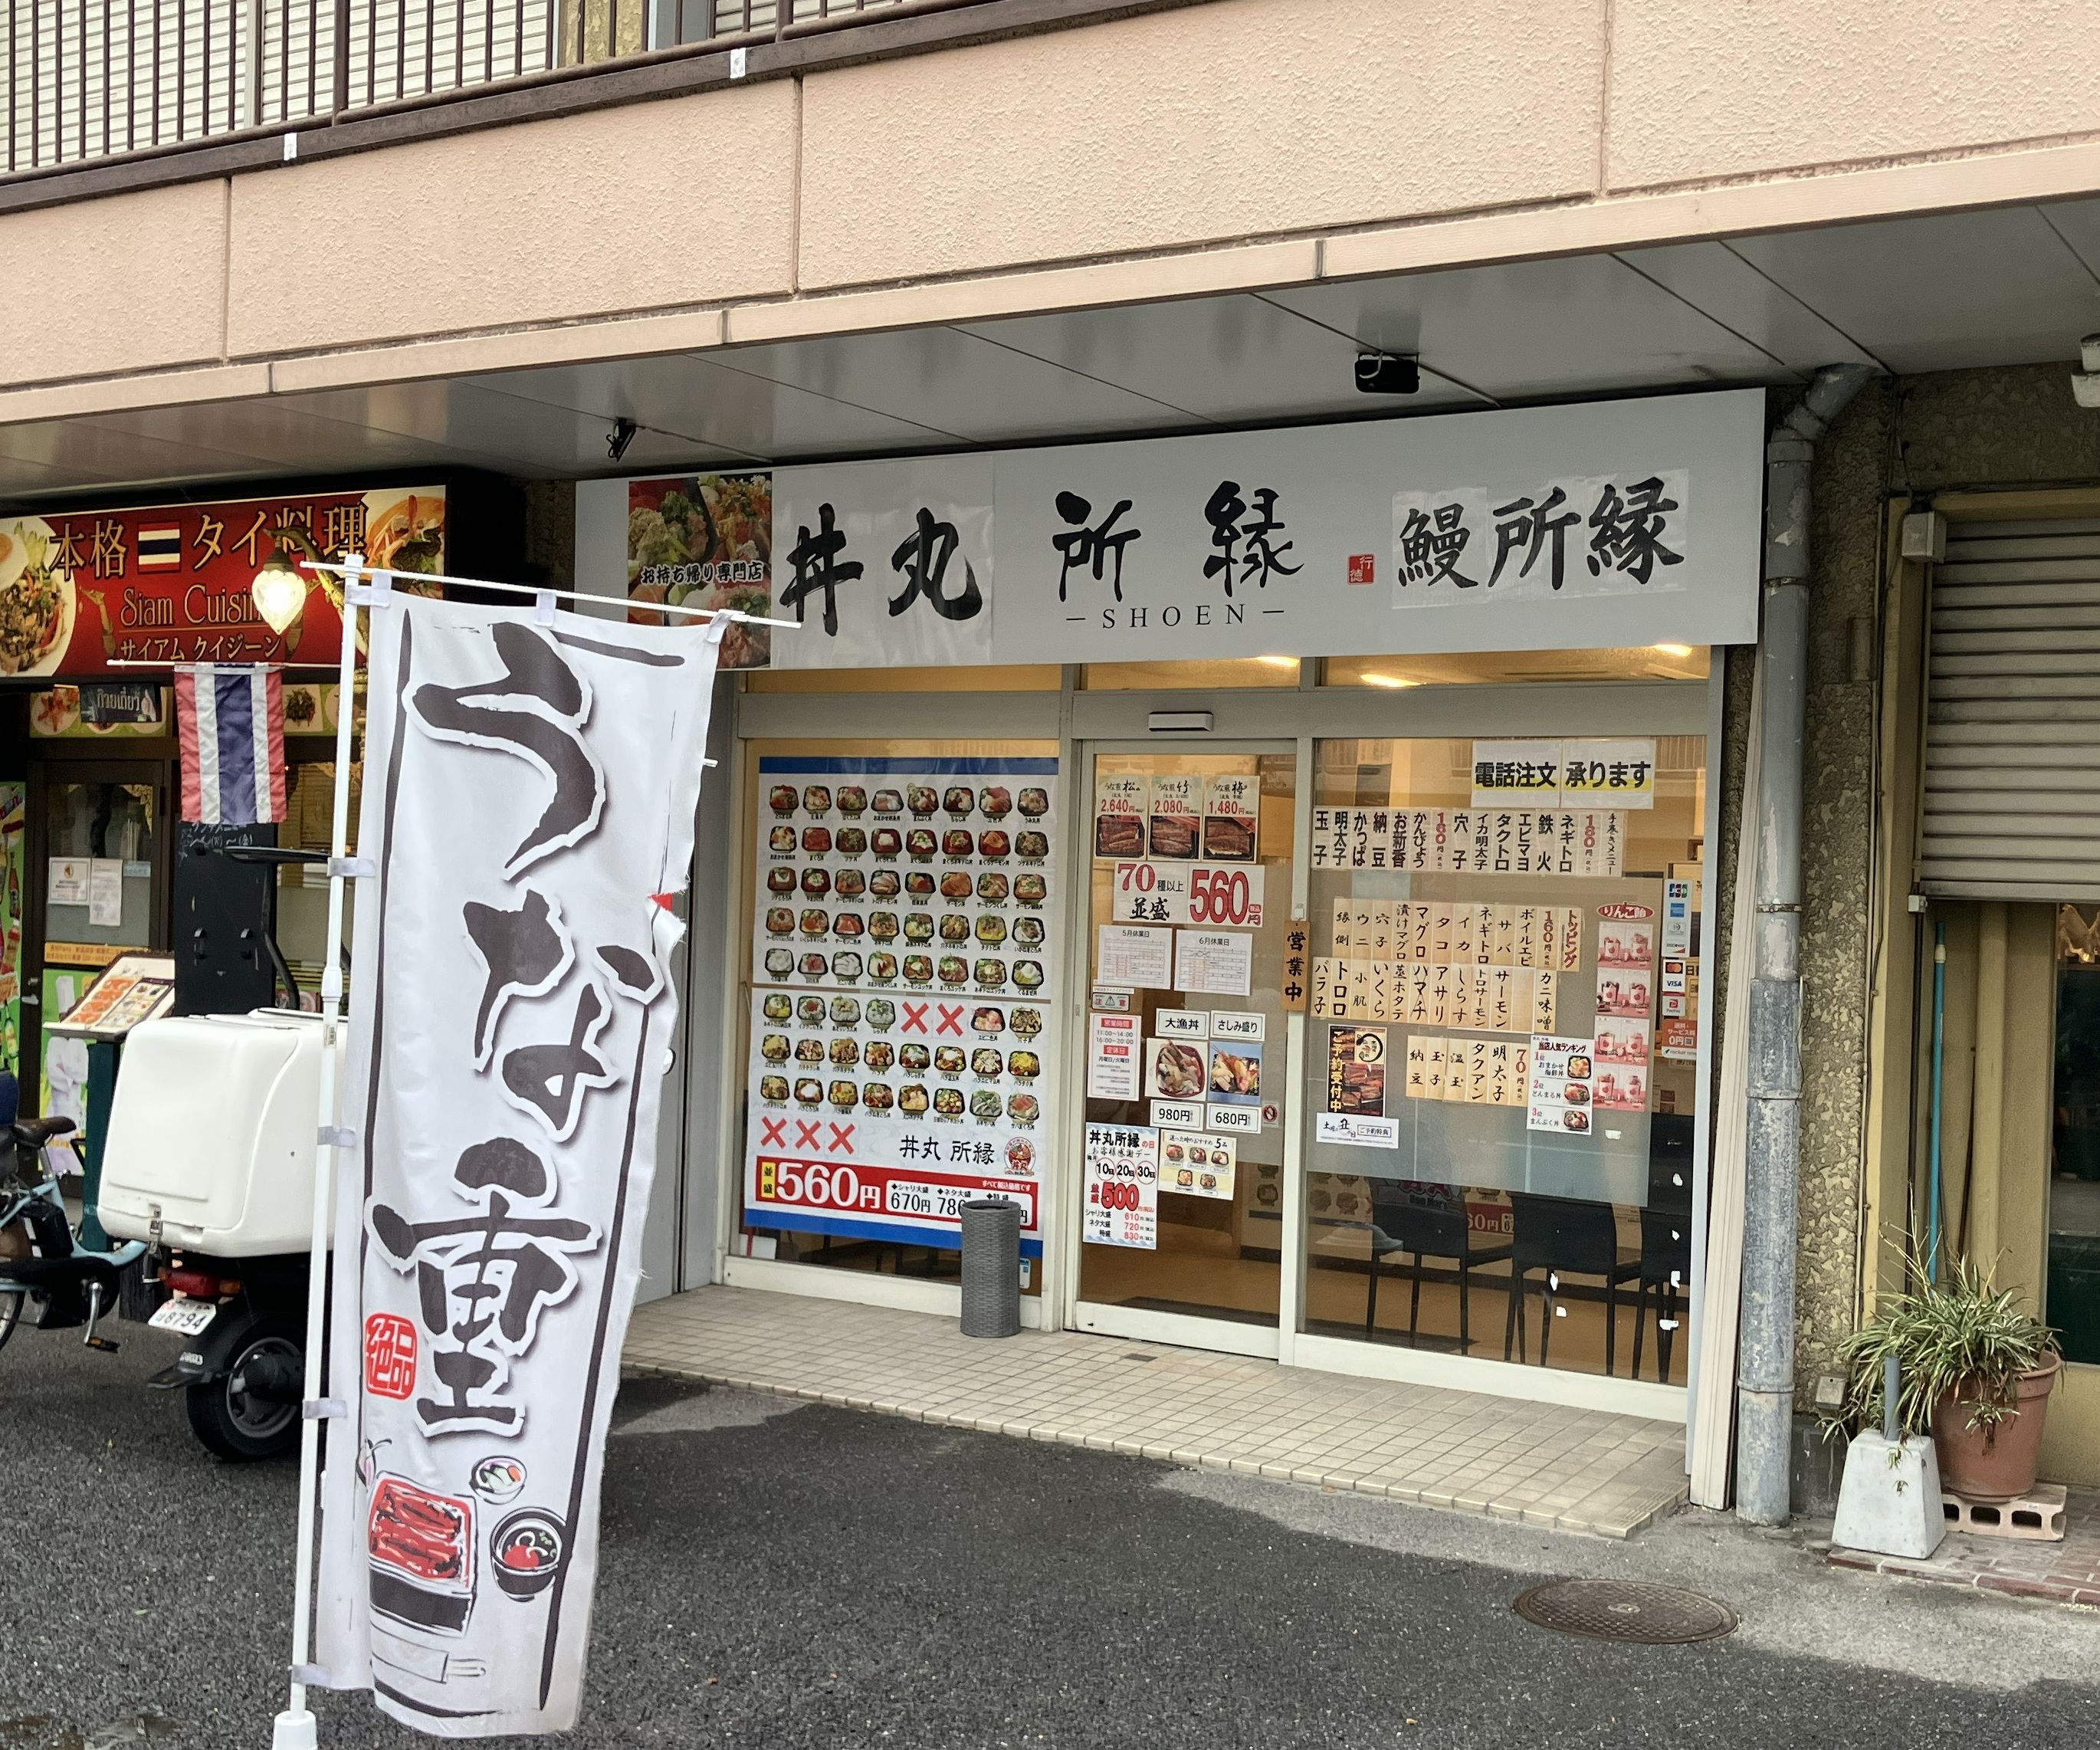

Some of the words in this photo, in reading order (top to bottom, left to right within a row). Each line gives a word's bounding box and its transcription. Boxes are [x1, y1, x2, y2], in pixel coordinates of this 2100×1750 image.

[50, 519, 127, 582] 本格
[1052, 481, 1304, 603] 所縁
[1397, 476, 1685, 590] 鰻所縁
[641, 560, 765, 586] お持ち帰り専門店
[779, 503, 983, 636] 丼丸
[120, 588, 173, 626] Siam
[1103, 603, 1245, 629] SHOEN
[121, 638, 185, 661] サイアム
[195, 634, 281, 660] クイジーン
[1475, 761, 1557, 788] 電話注文
[1565, 761, 1651, 788] 承ります
[1313, 810, 1329, 865] 玉子
[1333, 811, 1348, 866] 明太子
[1353, 812, 1367, 867] かっぱ
[1372, 812, 1387, 868] 納豆
[1392, 813, 1407, 868] お新香
[1413, 813, 1427, 868] かんぴょう
[1452, 813, 1468, 869] 穴子
[1475, 813, 1488, 870] イカ明太子
[1495, 814, 1511, 871] タクトロ
[1518, 814, 1531, 872] エビマヨ
[1537, 814, 1554, 872] 鉄火
[1560, 815, 1575, 872] ネギトロ
[1117, 864, 1183, 891] 70種以上
[1122, 930, 1150, 938] 5月休業日
[1130, 896, 1170, 921] 並盛
[1355, 914, 1369, 946] ウニ
[1375, 913, 1390, 947] 穴子
[1396, 904, 1410, 959] 漬けマグロ
[1416, 907, 1429, 957] マグロ
[1436, 917, 1450, 950] タコ
[1456, 917, 1470, 951] イカ
[1478, 907, 1492, 964] ネギトロ
[1199, 937, 1230, 947] 6月休業日
[1497, 920, 1511, 953] サバ
[1518, 908, 1534, 967] ボイルエビ
[1564, 909, 1578, 968] トッピング
[1285, 931, 1307, 1002] 営業中
[1314, 960, 1329, 1014] バラ子
[1333, 961, 1348, 1016] トロロ
[1353, 973, 1367, 1006] 小肌
[1374, 964, 1389, 1018] いくら
[1393, 964, 1407, 1019] 蒸ホタテ
[1434, 966, 1448, 1023] アサリ
[1453, 967, 1467, 1023] しらす
[1475, 969, 1487, 1026] トロサーモン
[1495, 970, 1509, 1027] サーモン
[1537, 972, 1553, 1030] カニ味噌
[1166, 1018, 1199, 1030] 大漁丼
[1218, 1020, 1258, 1033] さしみ盛り
[1330, 1031, 1344, 1113] ご予約受付中
[1409, 1049, 1424, 1085] 納豆
[1430, 1051, 1445, 1085] 玉子
[1450, 1052, 1464, 1087] 温玉
[1472, 1043, 1485, 1100] タクアン
[1492, 1045, 1507, 1102] 明太子
[1159, 1108, 1190, 1121] 980円
[1216, 1112, 1248, 1125] 680円
[900, 1134, 942, 1161] 丼丸
[950, 1141, 995, 1165] 所縁
[776, 1161, 881, 1209] 560円
[891, 1192, 930, 1213] 670円
